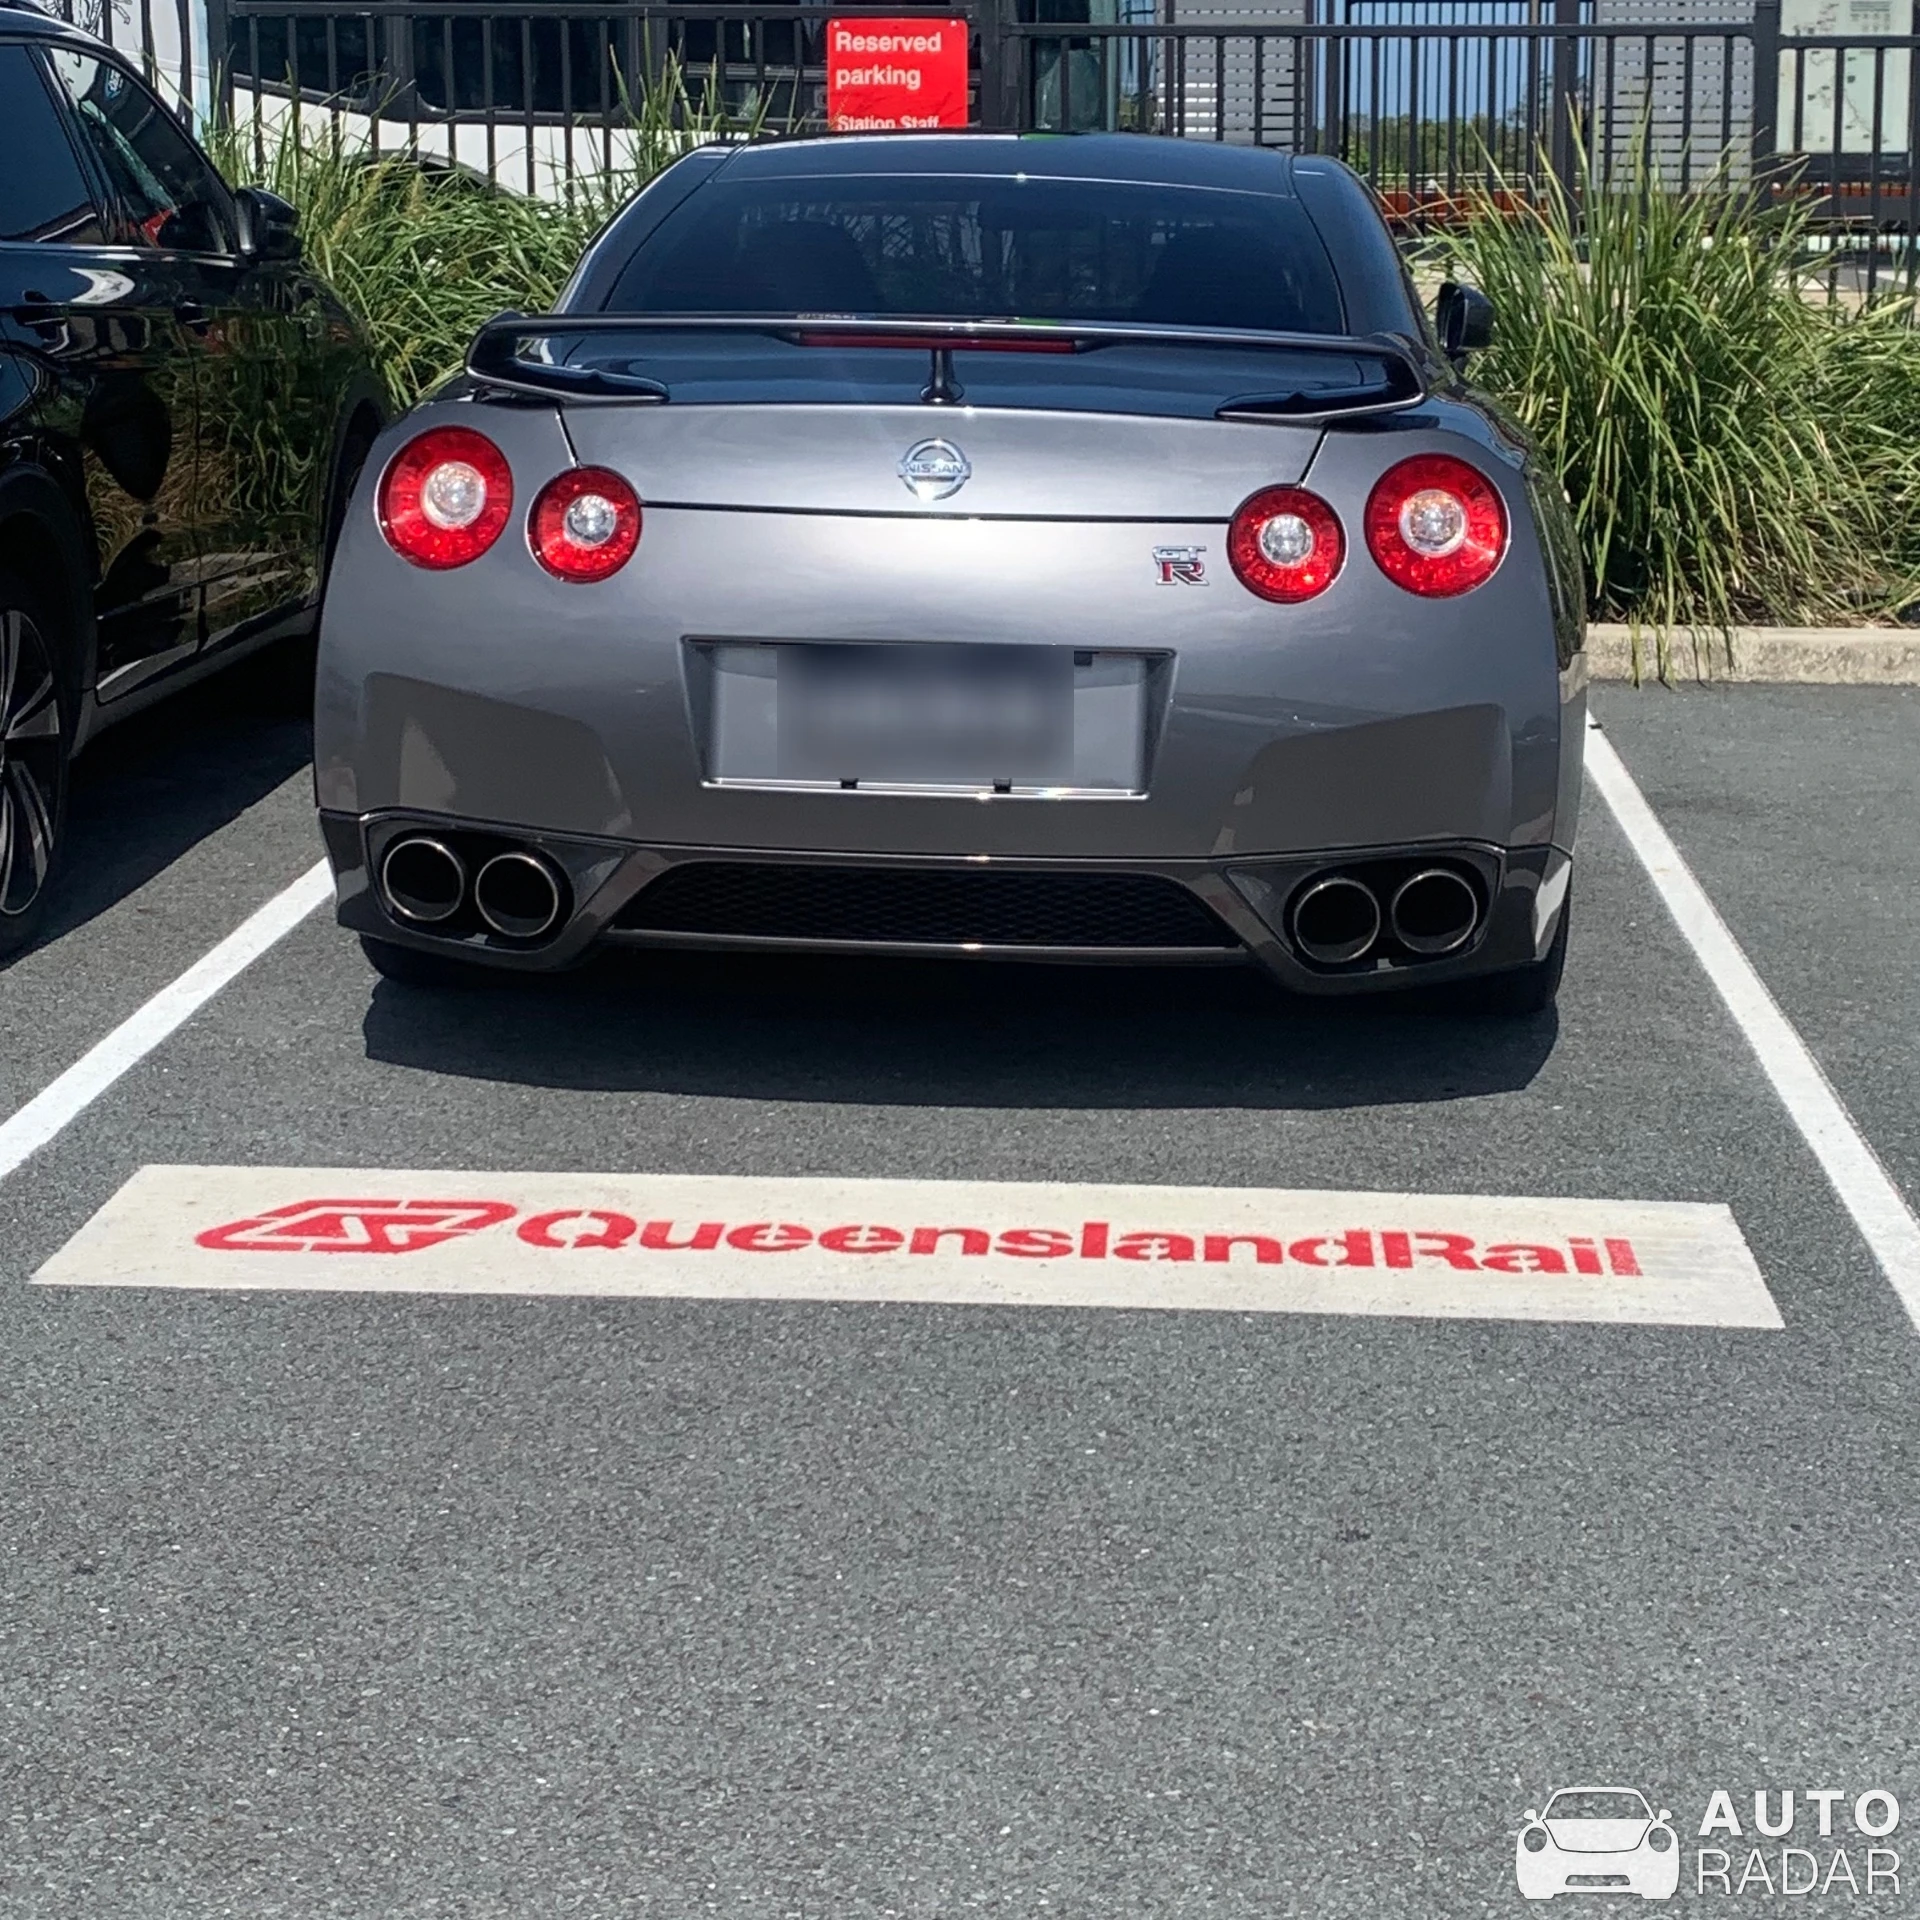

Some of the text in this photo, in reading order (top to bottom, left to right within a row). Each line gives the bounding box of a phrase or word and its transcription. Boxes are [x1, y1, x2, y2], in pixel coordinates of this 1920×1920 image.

[836, 31, 942, 52] Reserved
[836, 64, 921, 91] parking
[837, 115, 940, 131] Station Staff
[905, 463, 964, 474] NISSAN
